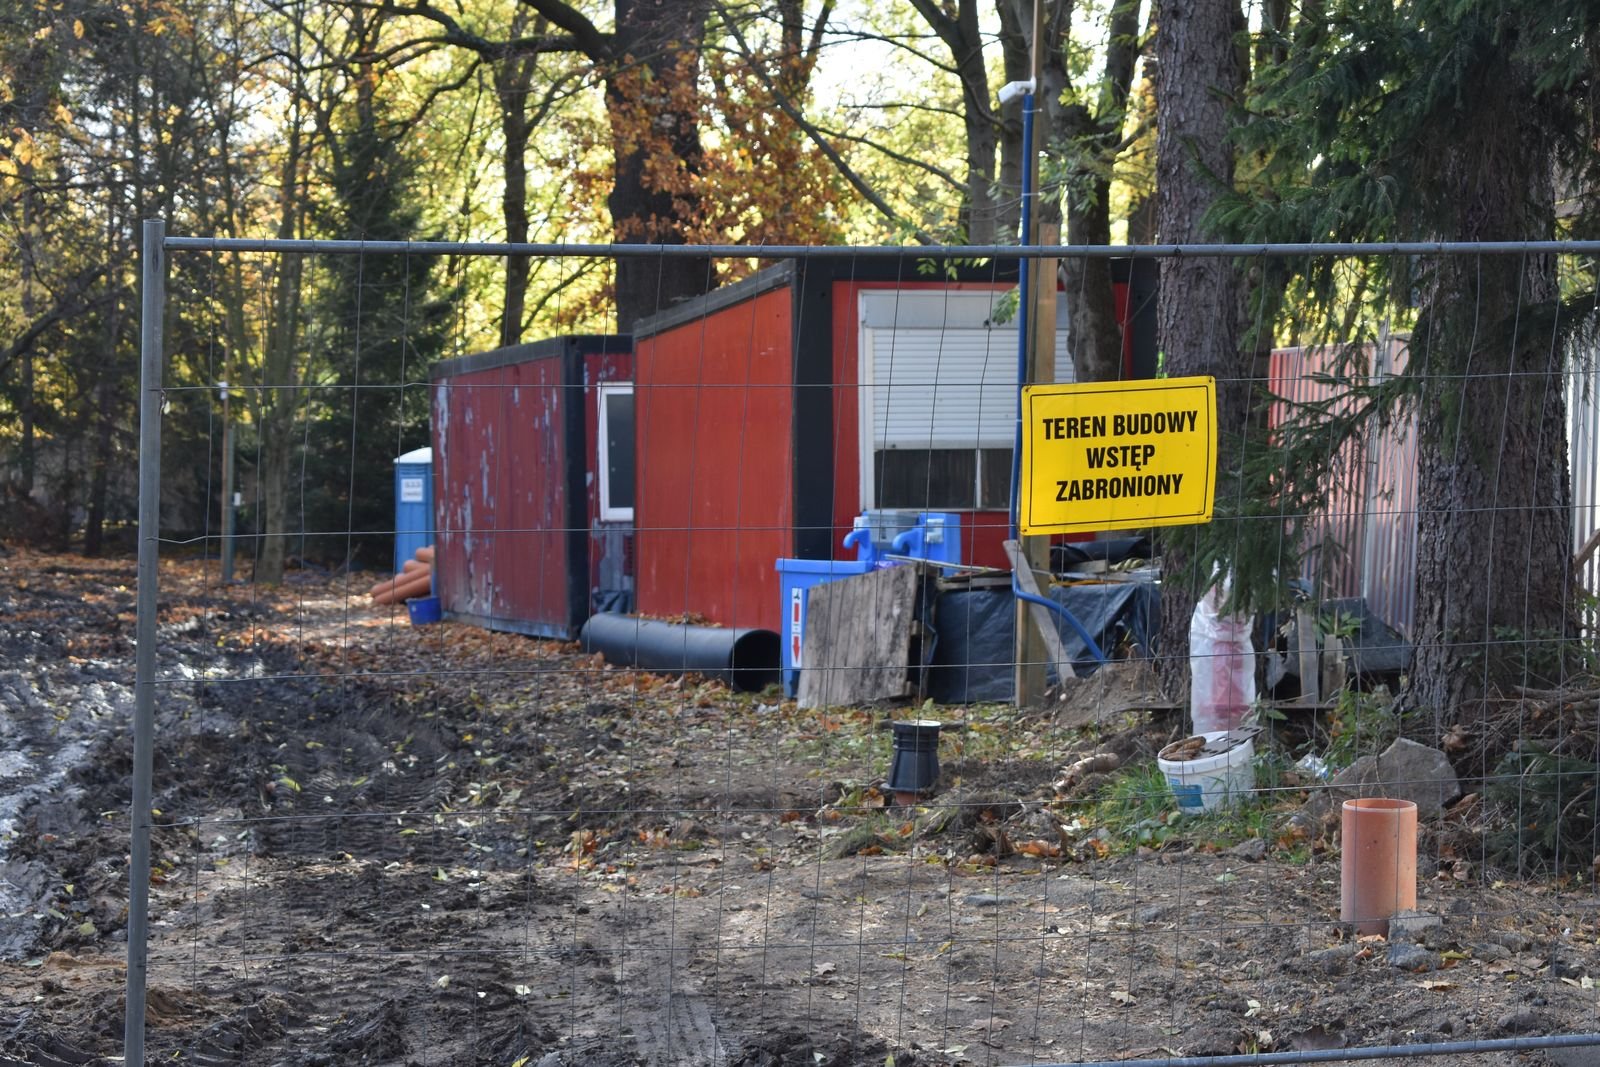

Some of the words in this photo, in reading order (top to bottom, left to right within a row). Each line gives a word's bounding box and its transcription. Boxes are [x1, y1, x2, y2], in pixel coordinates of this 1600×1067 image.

[1043, 415, 1106, 440] TEREN
[1113, 410, 1198, 436] BUDOWY
[1086, 444, 1156, 471] WSTĘP
[1055, 473, 1183, 502] ZABRONIONY
